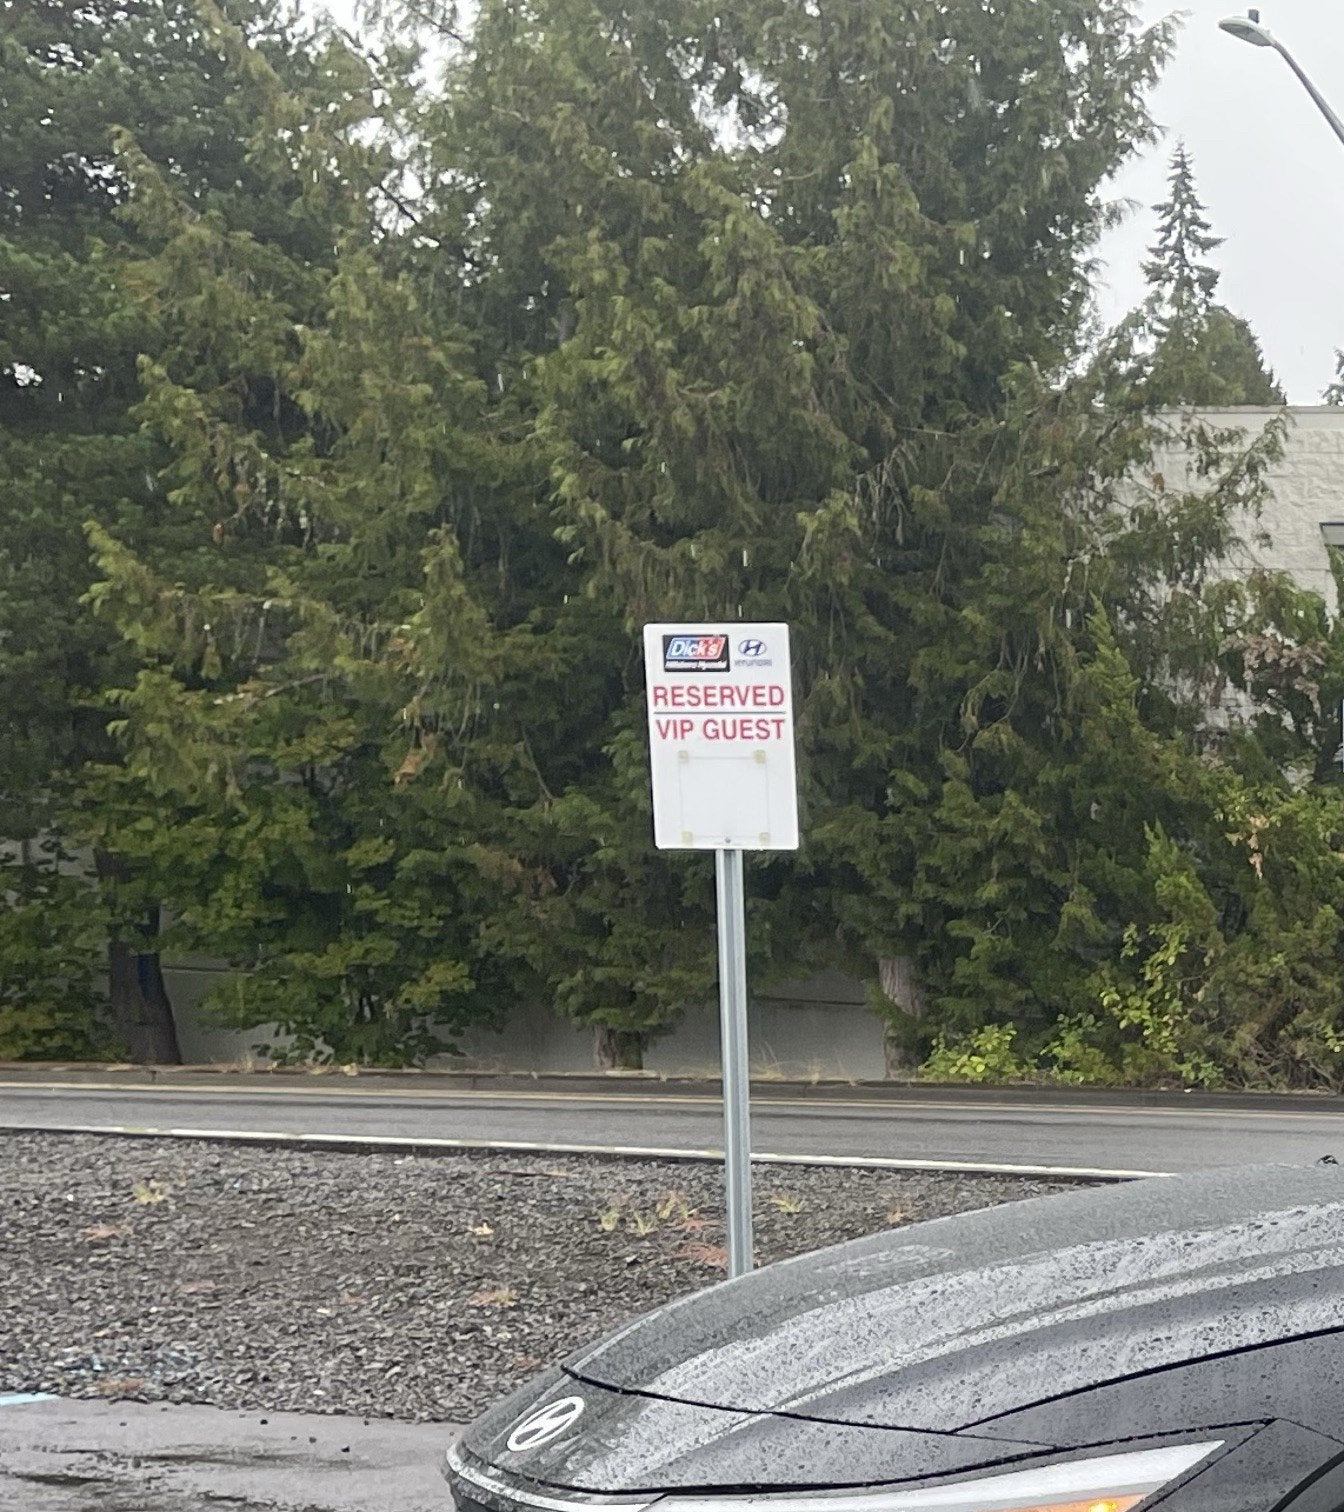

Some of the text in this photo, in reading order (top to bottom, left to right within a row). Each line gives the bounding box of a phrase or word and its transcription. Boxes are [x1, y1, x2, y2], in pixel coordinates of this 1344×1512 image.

[653, 685, 785, 707] RESERVED
[655, 719, 786, 740] VIP GUEST
